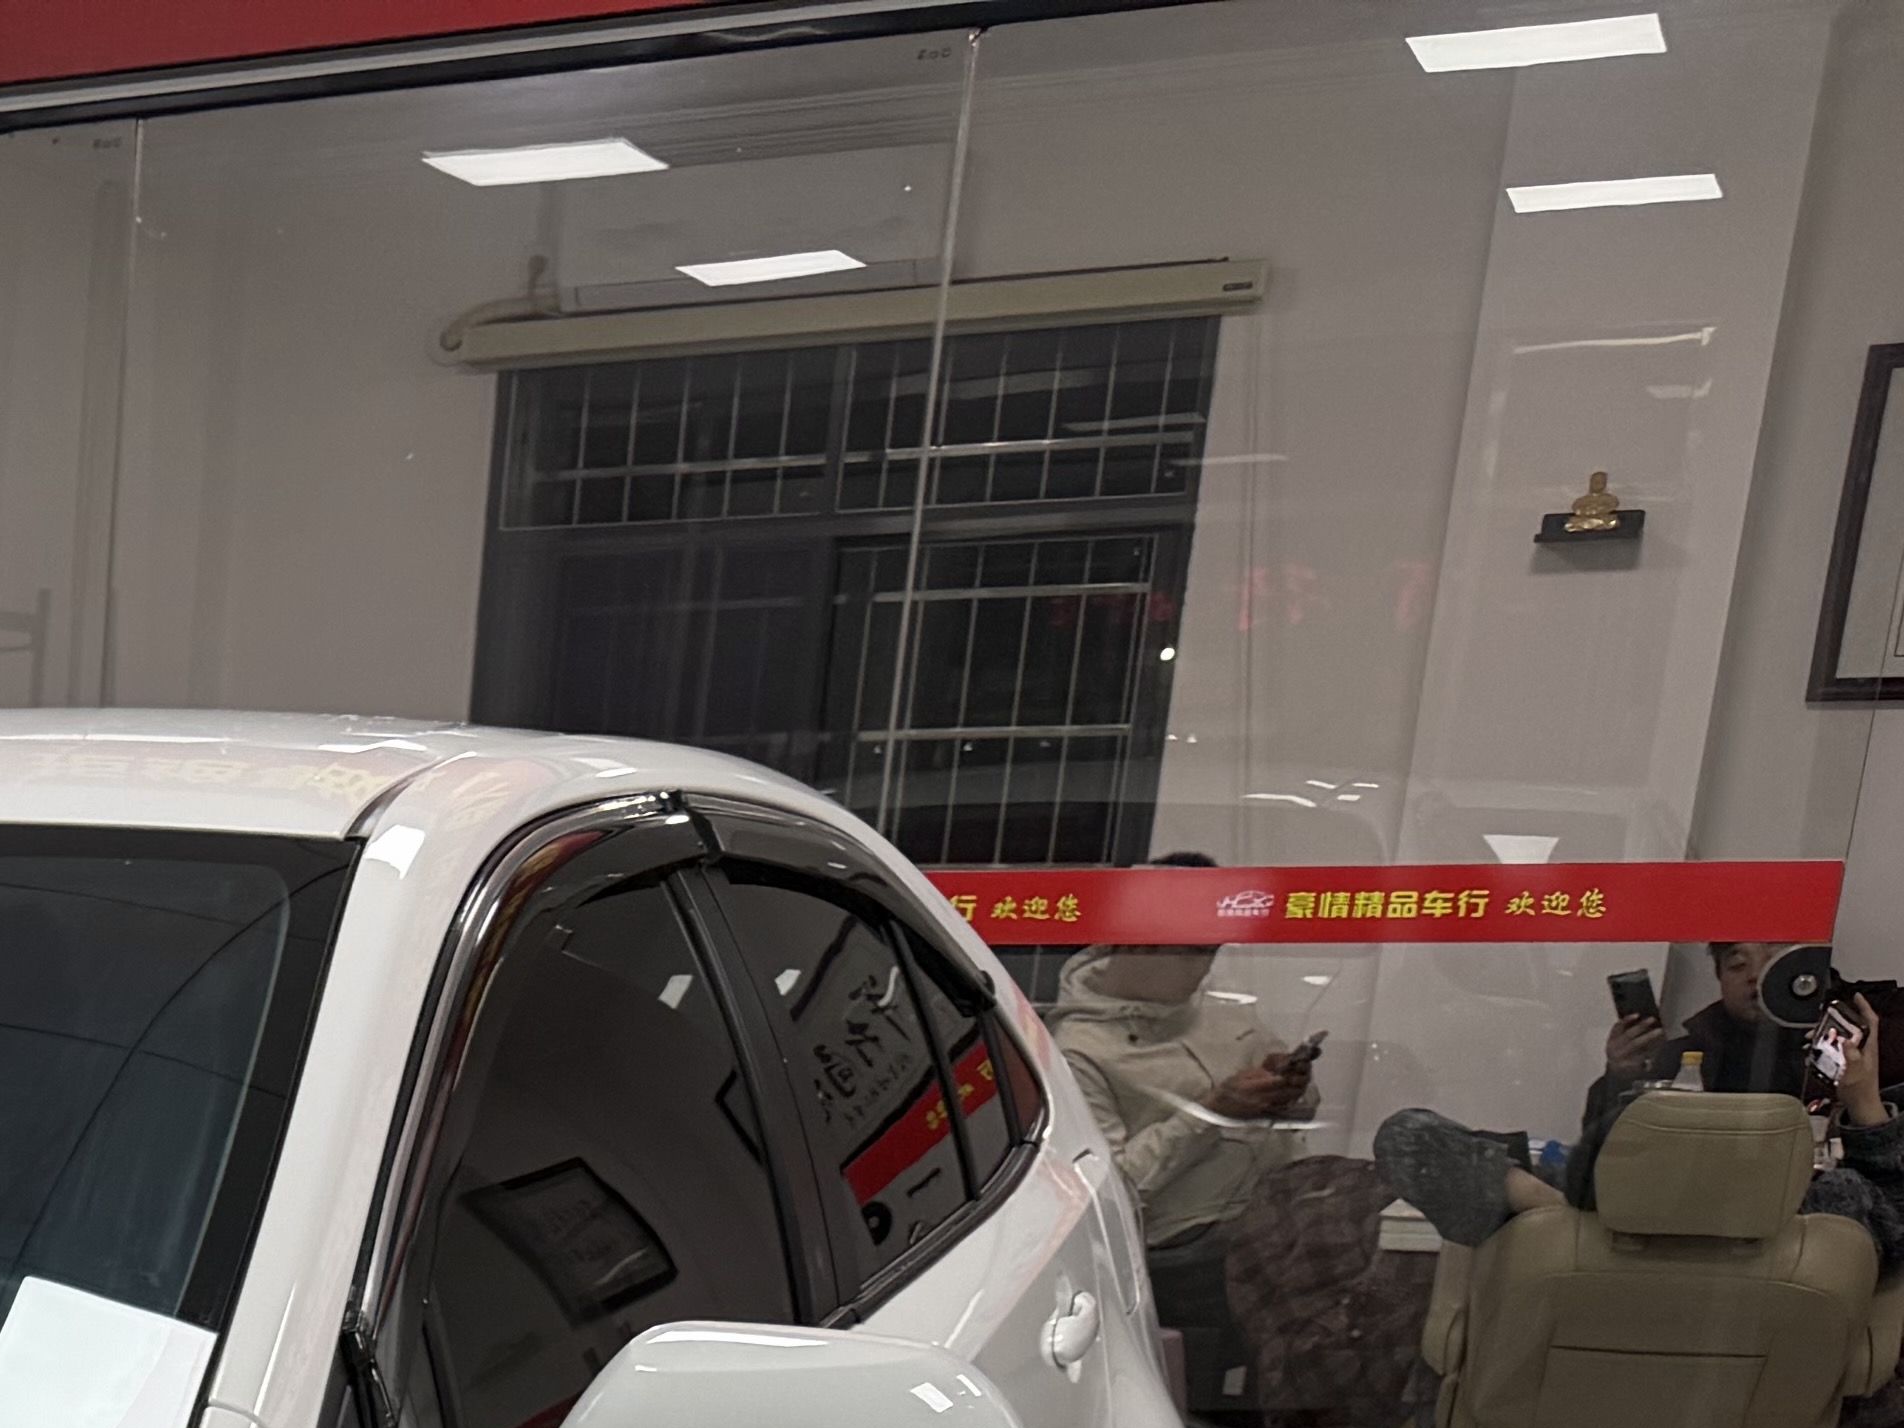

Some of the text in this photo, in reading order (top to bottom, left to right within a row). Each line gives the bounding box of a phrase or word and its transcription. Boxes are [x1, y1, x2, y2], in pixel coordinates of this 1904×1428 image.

[991, 893, 1081, 922] 欢迎您
[1284, 889, 1606, 919] 豪情精品车行 欢迎您
